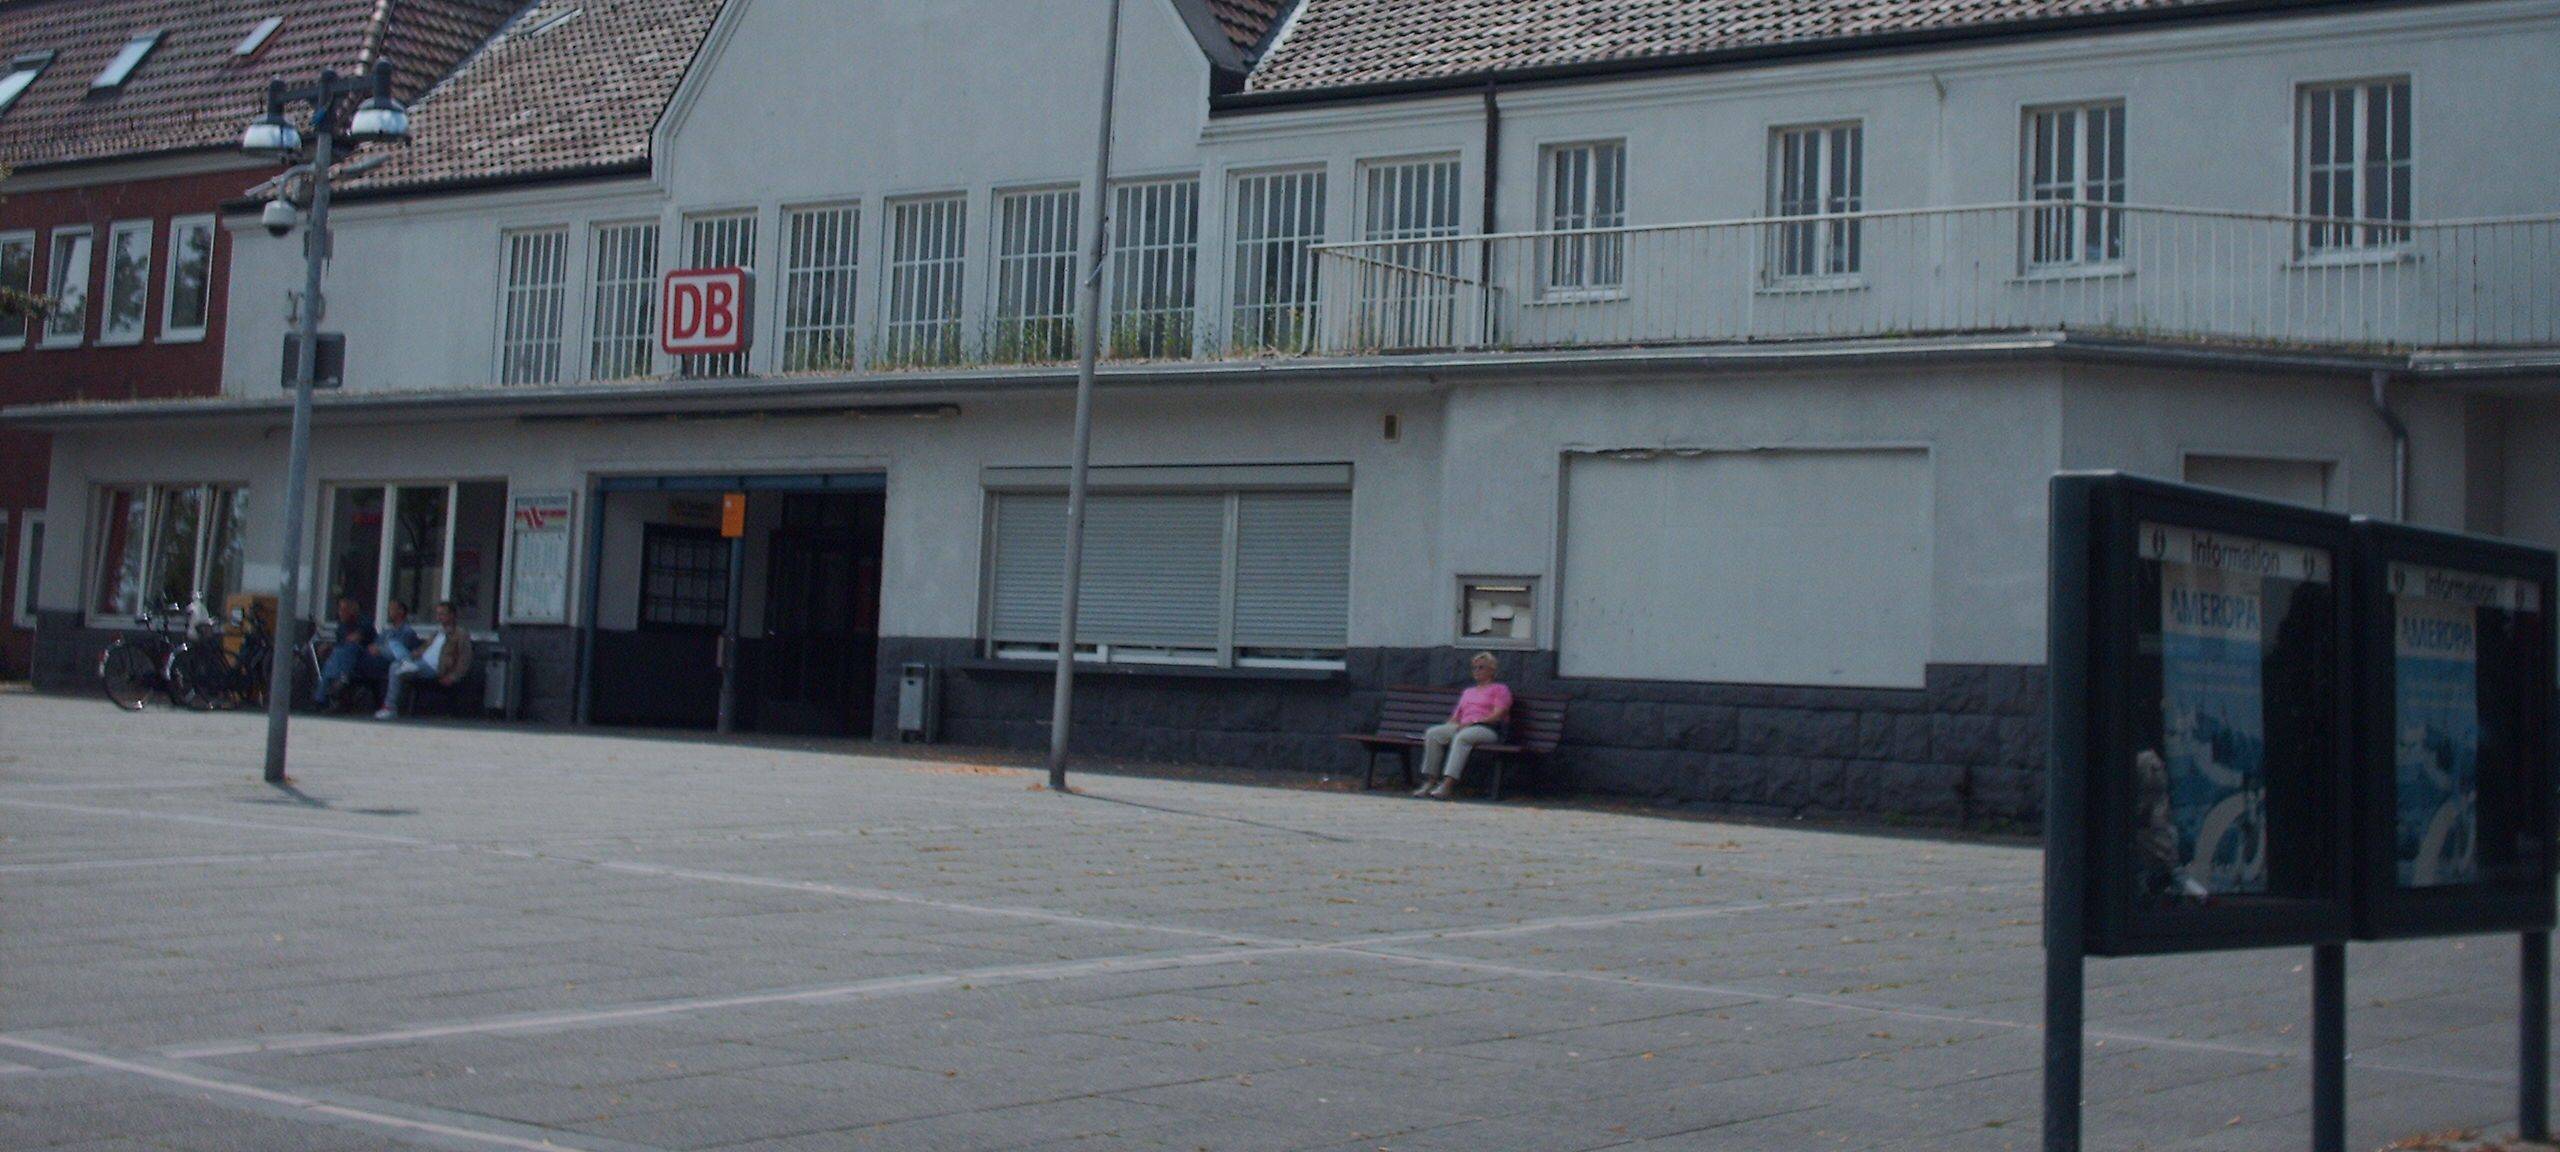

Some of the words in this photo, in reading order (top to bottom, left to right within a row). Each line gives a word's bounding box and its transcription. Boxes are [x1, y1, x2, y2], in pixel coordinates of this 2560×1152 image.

[673, 281, 733, 339] DB
[2191, 532, 2279, 574] Information
[2170, 588, 2258, 632] AMEROPA
